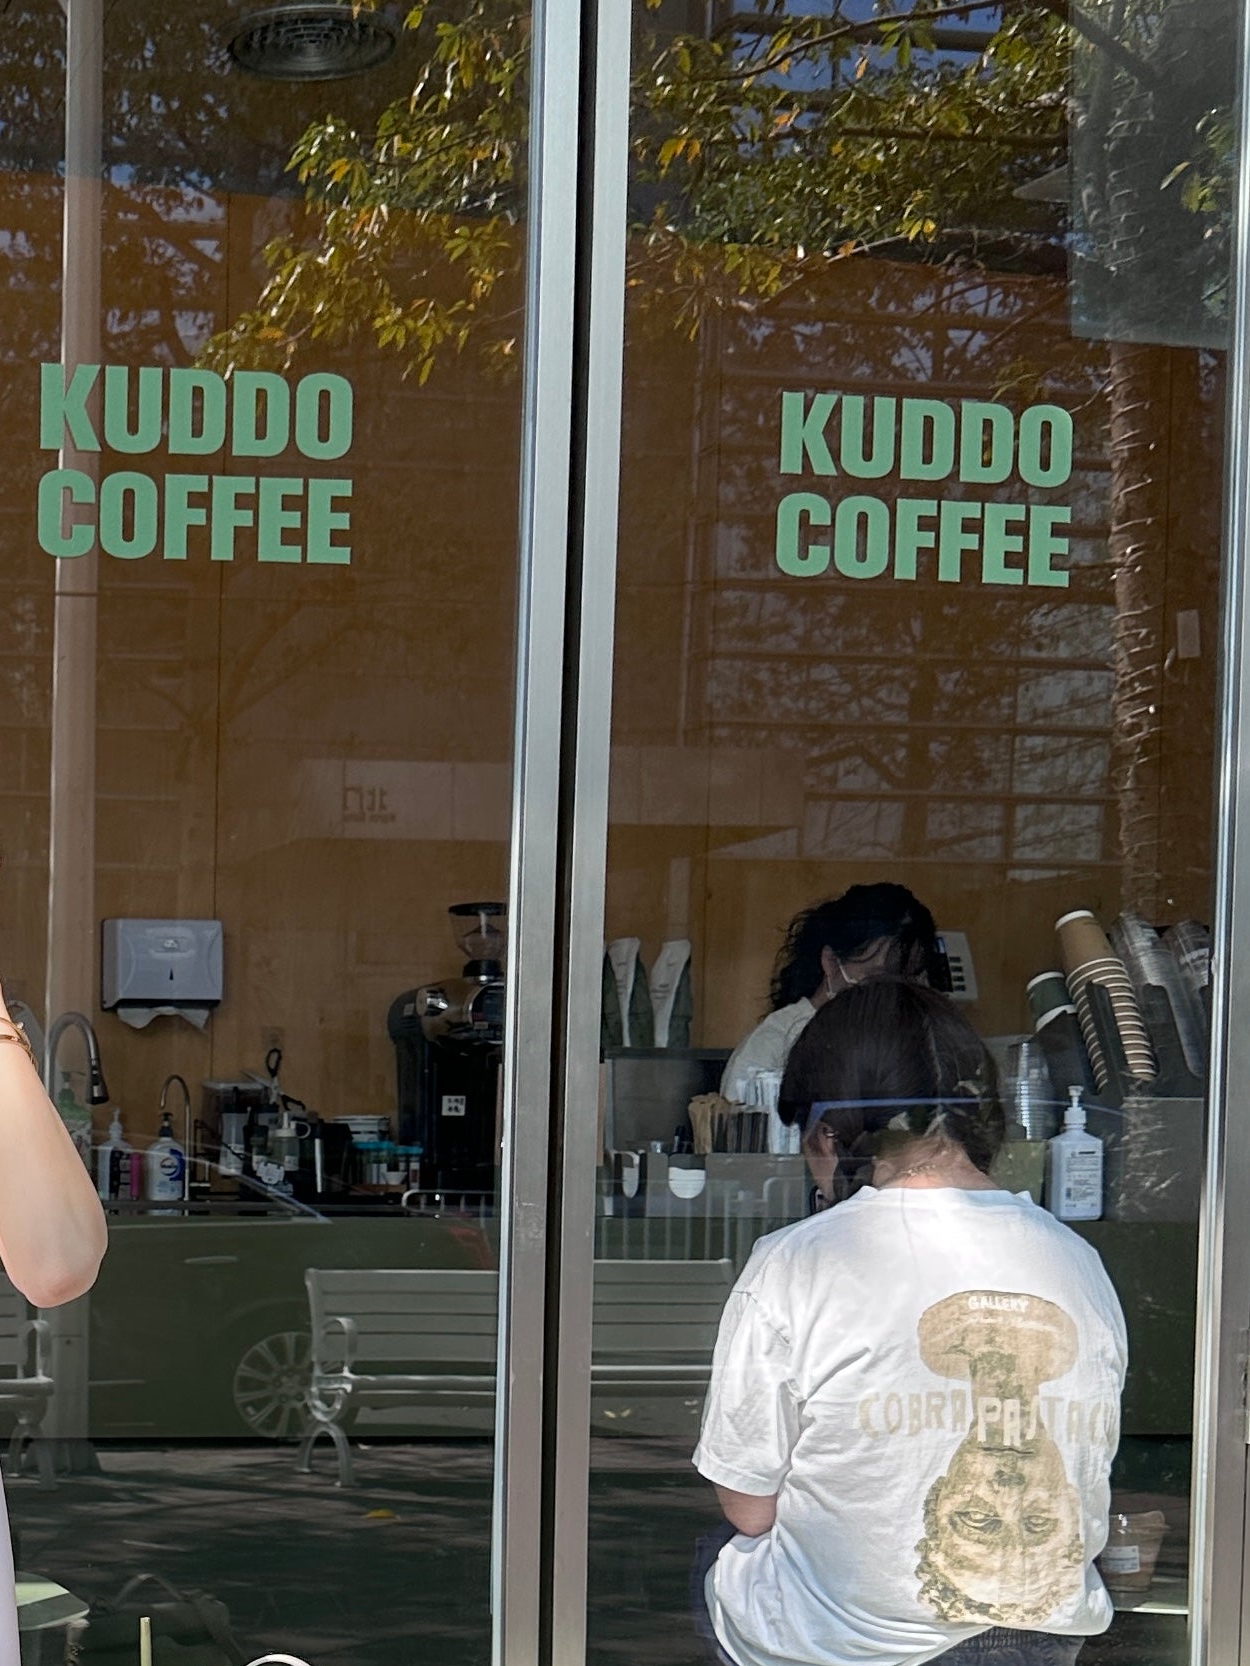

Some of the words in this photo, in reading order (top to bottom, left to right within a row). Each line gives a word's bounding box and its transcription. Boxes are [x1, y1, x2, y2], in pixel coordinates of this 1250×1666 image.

[40, 362, 354, 460] KUDDO
[780, 391, 1073, 488] KUDDO
[37, 469, 353, 564] COFFEE
[776, 492, 1072, 587] COFFEE
[968, 1295, 1029, 1313] GALLERY
